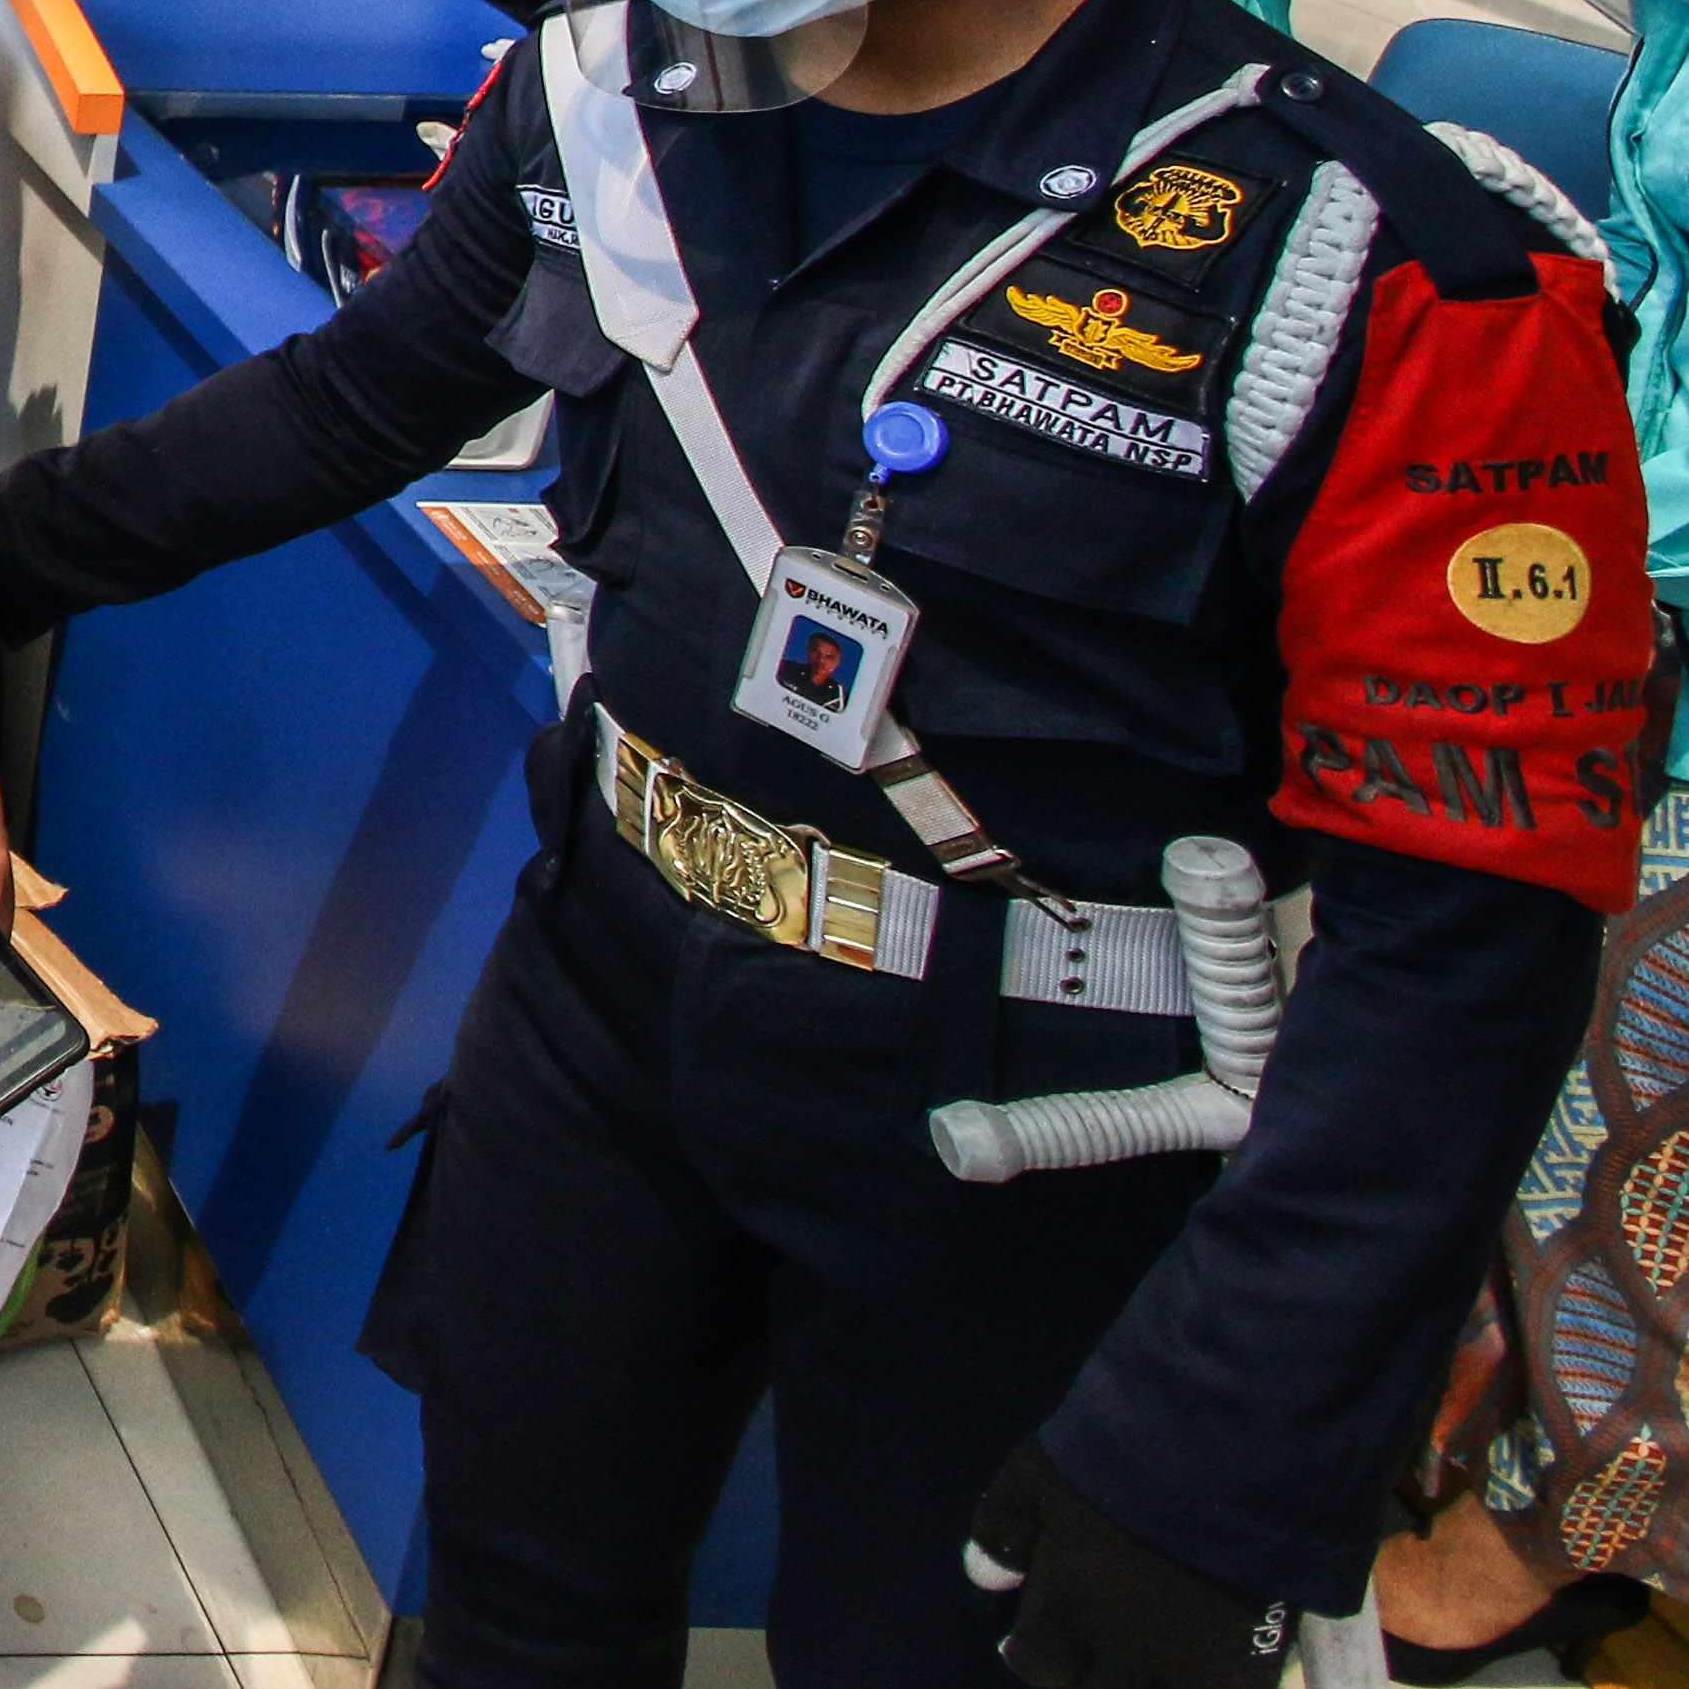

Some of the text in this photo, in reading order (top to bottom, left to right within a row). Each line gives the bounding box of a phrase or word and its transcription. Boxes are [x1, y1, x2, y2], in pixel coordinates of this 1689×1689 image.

[971, 357, 1175, 445] SATPAM
[1119, 437, 1194, 470] NSP
[1405, 451, 1611, 495] SATPAM
[807, 588, 890, 636] BHAWATA
[1361, 674, 1526, 716] DAOP
[1547, 682, 1575, 718] I
[1298, 722, 1537, 830] PAM
